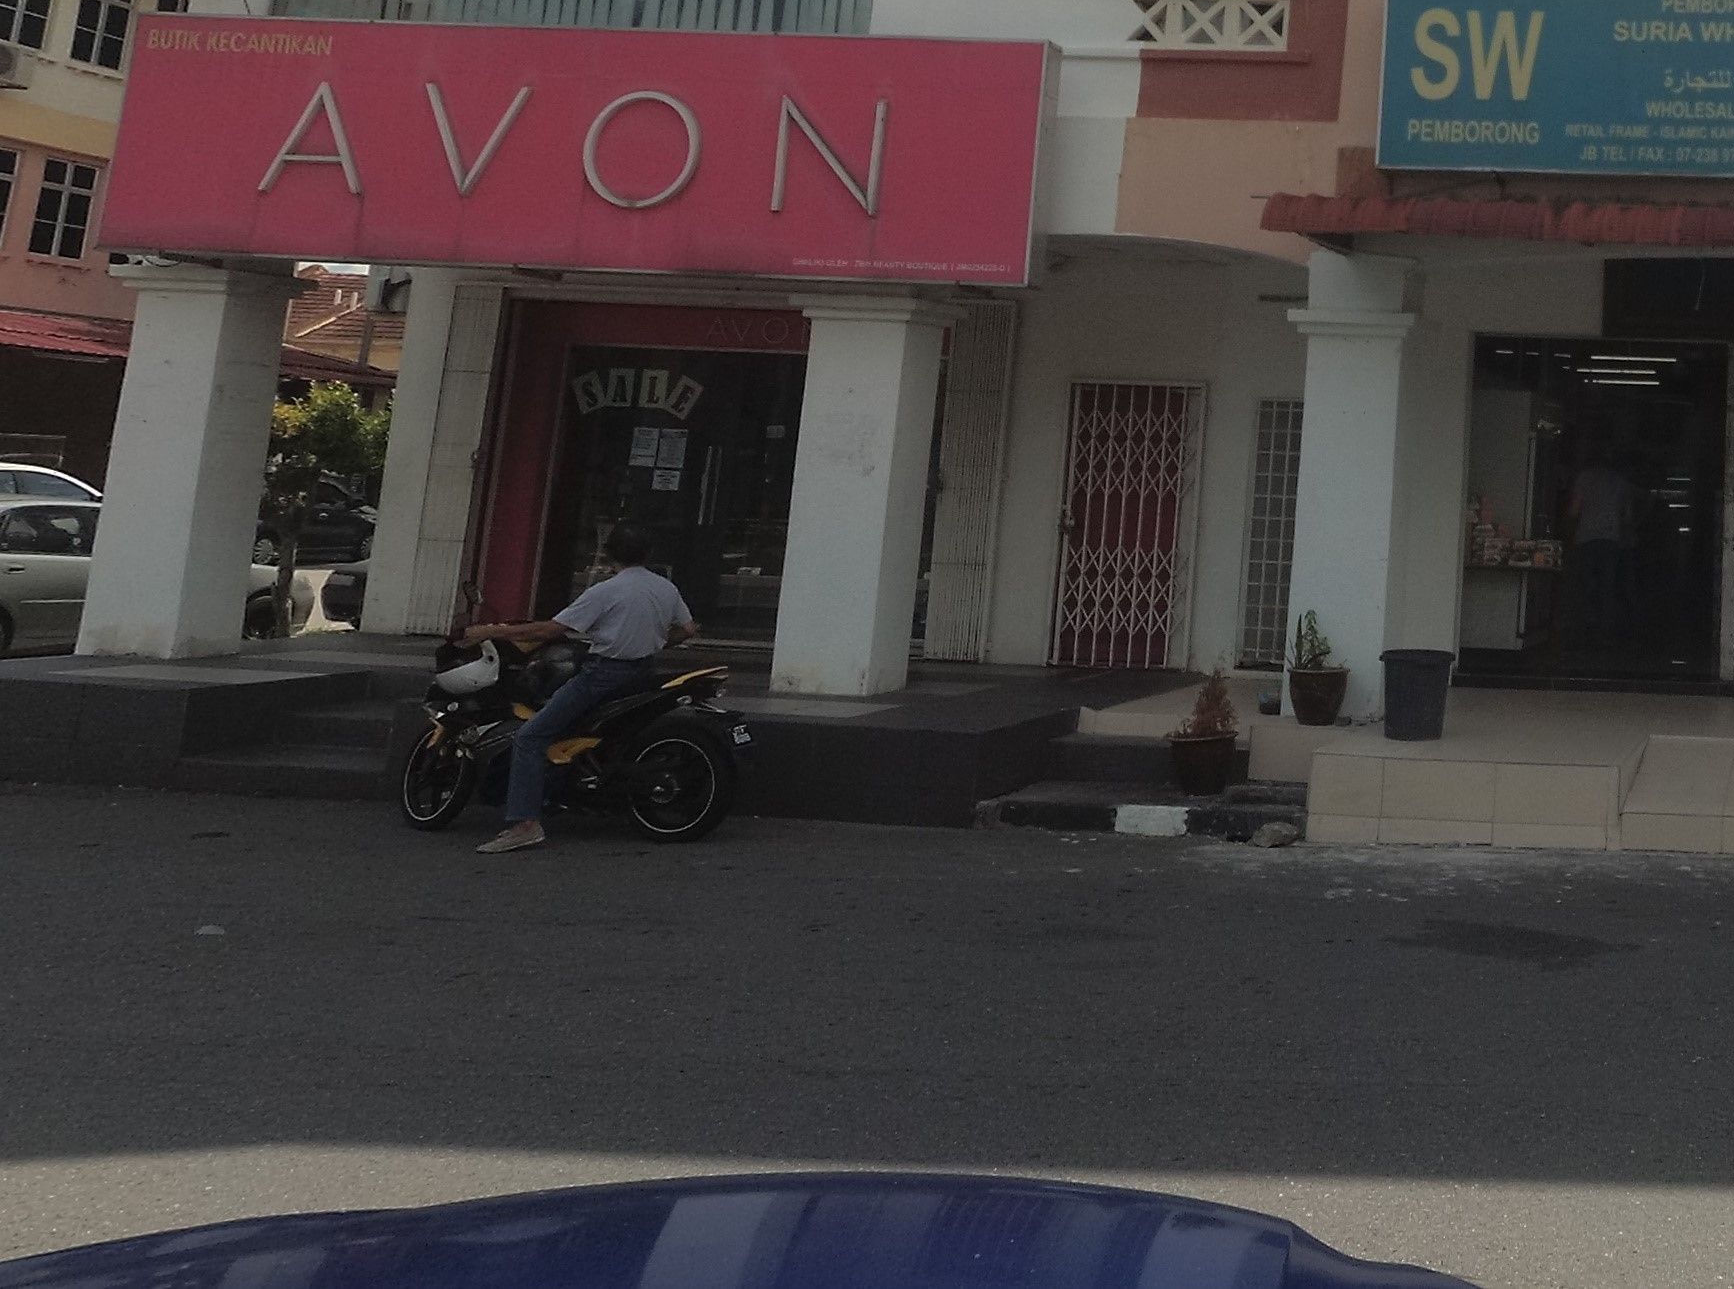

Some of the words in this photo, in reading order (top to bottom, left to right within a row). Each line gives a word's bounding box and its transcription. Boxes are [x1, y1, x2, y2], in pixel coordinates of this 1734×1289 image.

[147, 28, 200, 52] BUTIK
[207, 31, 333, 56] KECANTIKAN
[1614, 21, 1693, 44] SURIA
[1411, 8, 1545, 101] SW
[1408, 120, 1540, 144] PEMBORONG
[1660, 125, 1707, 140] ISLAMIC
[257, 81, 889, 219] AVON
[1579, 146, 1597, 162] JB
[1602, 146, 1627, 162] TEL
[580, 373, 696, 413] SALE
